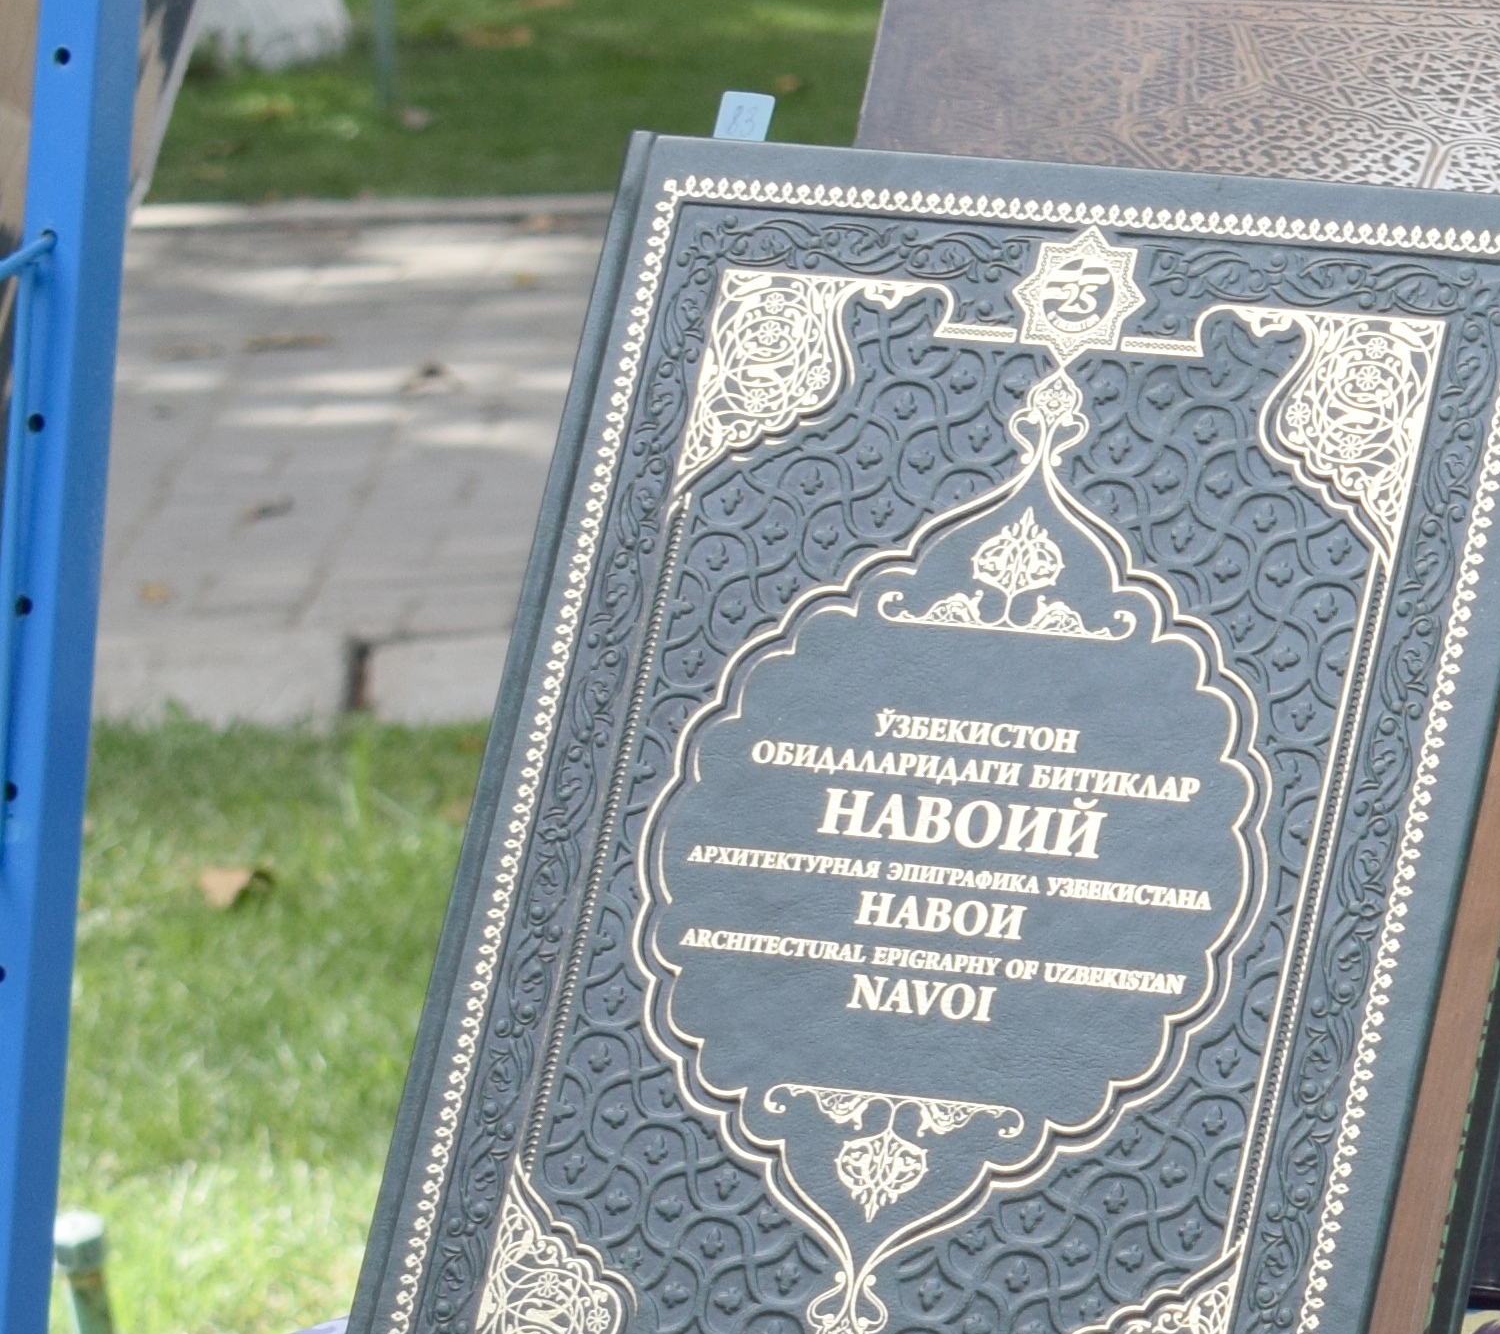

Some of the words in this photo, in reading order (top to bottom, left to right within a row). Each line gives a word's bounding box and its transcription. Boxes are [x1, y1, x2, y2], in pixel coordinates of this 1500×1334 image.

[874, 709, 1079, 753] ЎЗБЕКИСТОН
[751, 740, 1019, 787] ОБИДАЛАРИДАГИ
[1029, 766, 1200, 803] БИТИКЛАР
[818, 788, 1106, 859] НАВОИЙ
[687, 845, 880, 879] АРХИТЕКТУРНАЯ
[886, 862, 1039, 895] ЭПИГРАФИКА
[1046, 876, 1211, 910] УЗБЕКИСТАНА
[855, 892, 1026, 940] НАВОИ
[680, 928, 865, 963] ARCHITECTURAL
[873, 946, 1001, 977] EPIGRAPHY
[1005, 957, 1038, 979] OF
[1043, 962, 1185, 994] UZBEKISTAN
[847, 974, 995, 1022] NAVOI
